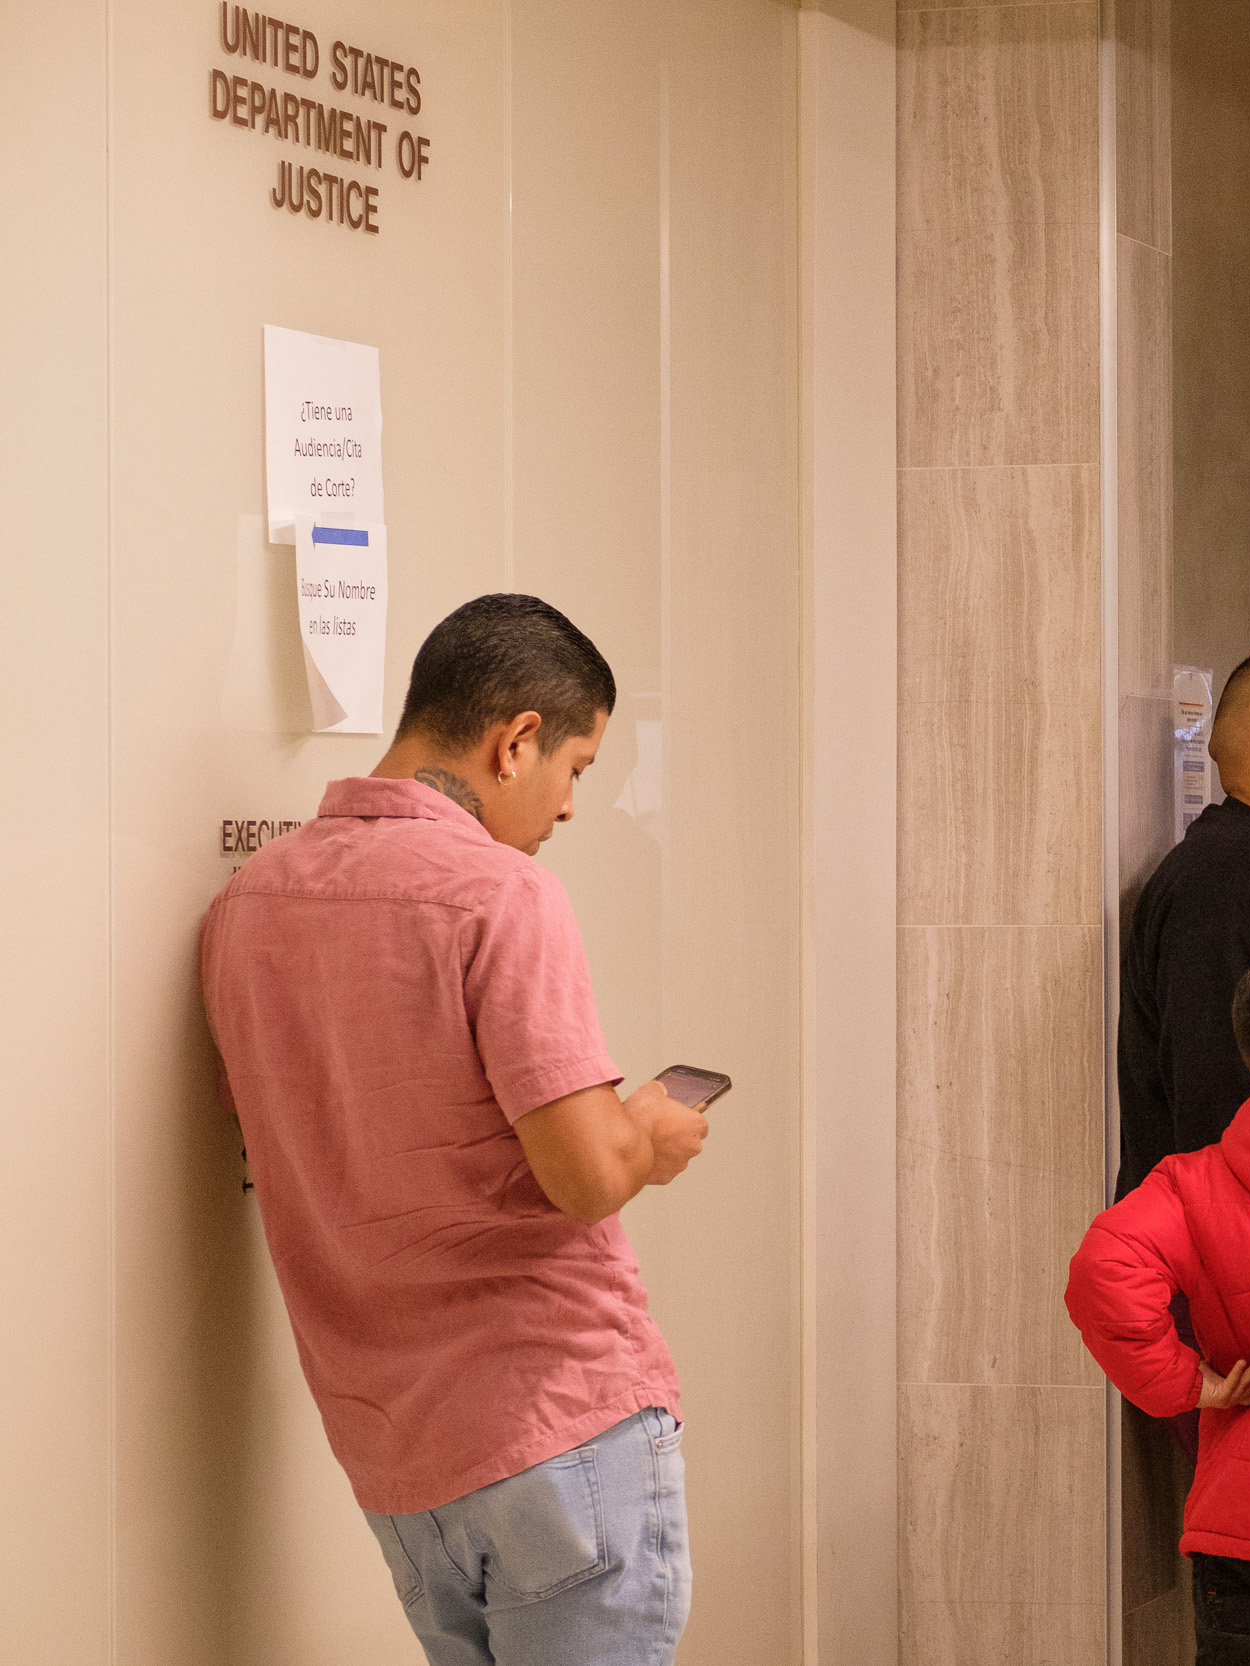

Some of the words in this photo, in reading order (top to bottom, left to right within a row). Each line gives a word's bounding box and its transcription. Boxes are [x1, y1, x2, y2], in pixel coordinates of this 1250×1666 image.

[221, 1, 319, 79] UNITED
[331, 40, 421, 116] STATES
[212, 68, 388, 169] DEPARTMENT
[398, 130, 430, 181] OF
[271, 160, 379, 234] JUSTICE
[300, 401, 332, 422] ¿Tiene
[335, 406, 353, 421] una
[293, 437, 362, 461] Audiencia/Cita
[310, 477, 323, 497] de
[325, 477, 355, 497] Corte?
[301, 577, 322, 601] Busque
[324, 579, 336, 599] Su
[338, 580, 376, 600] Nombre
[309, 619, 318, 635] en
[319, 614, 331, 635] las
[333, 616, 356, 636] listas
